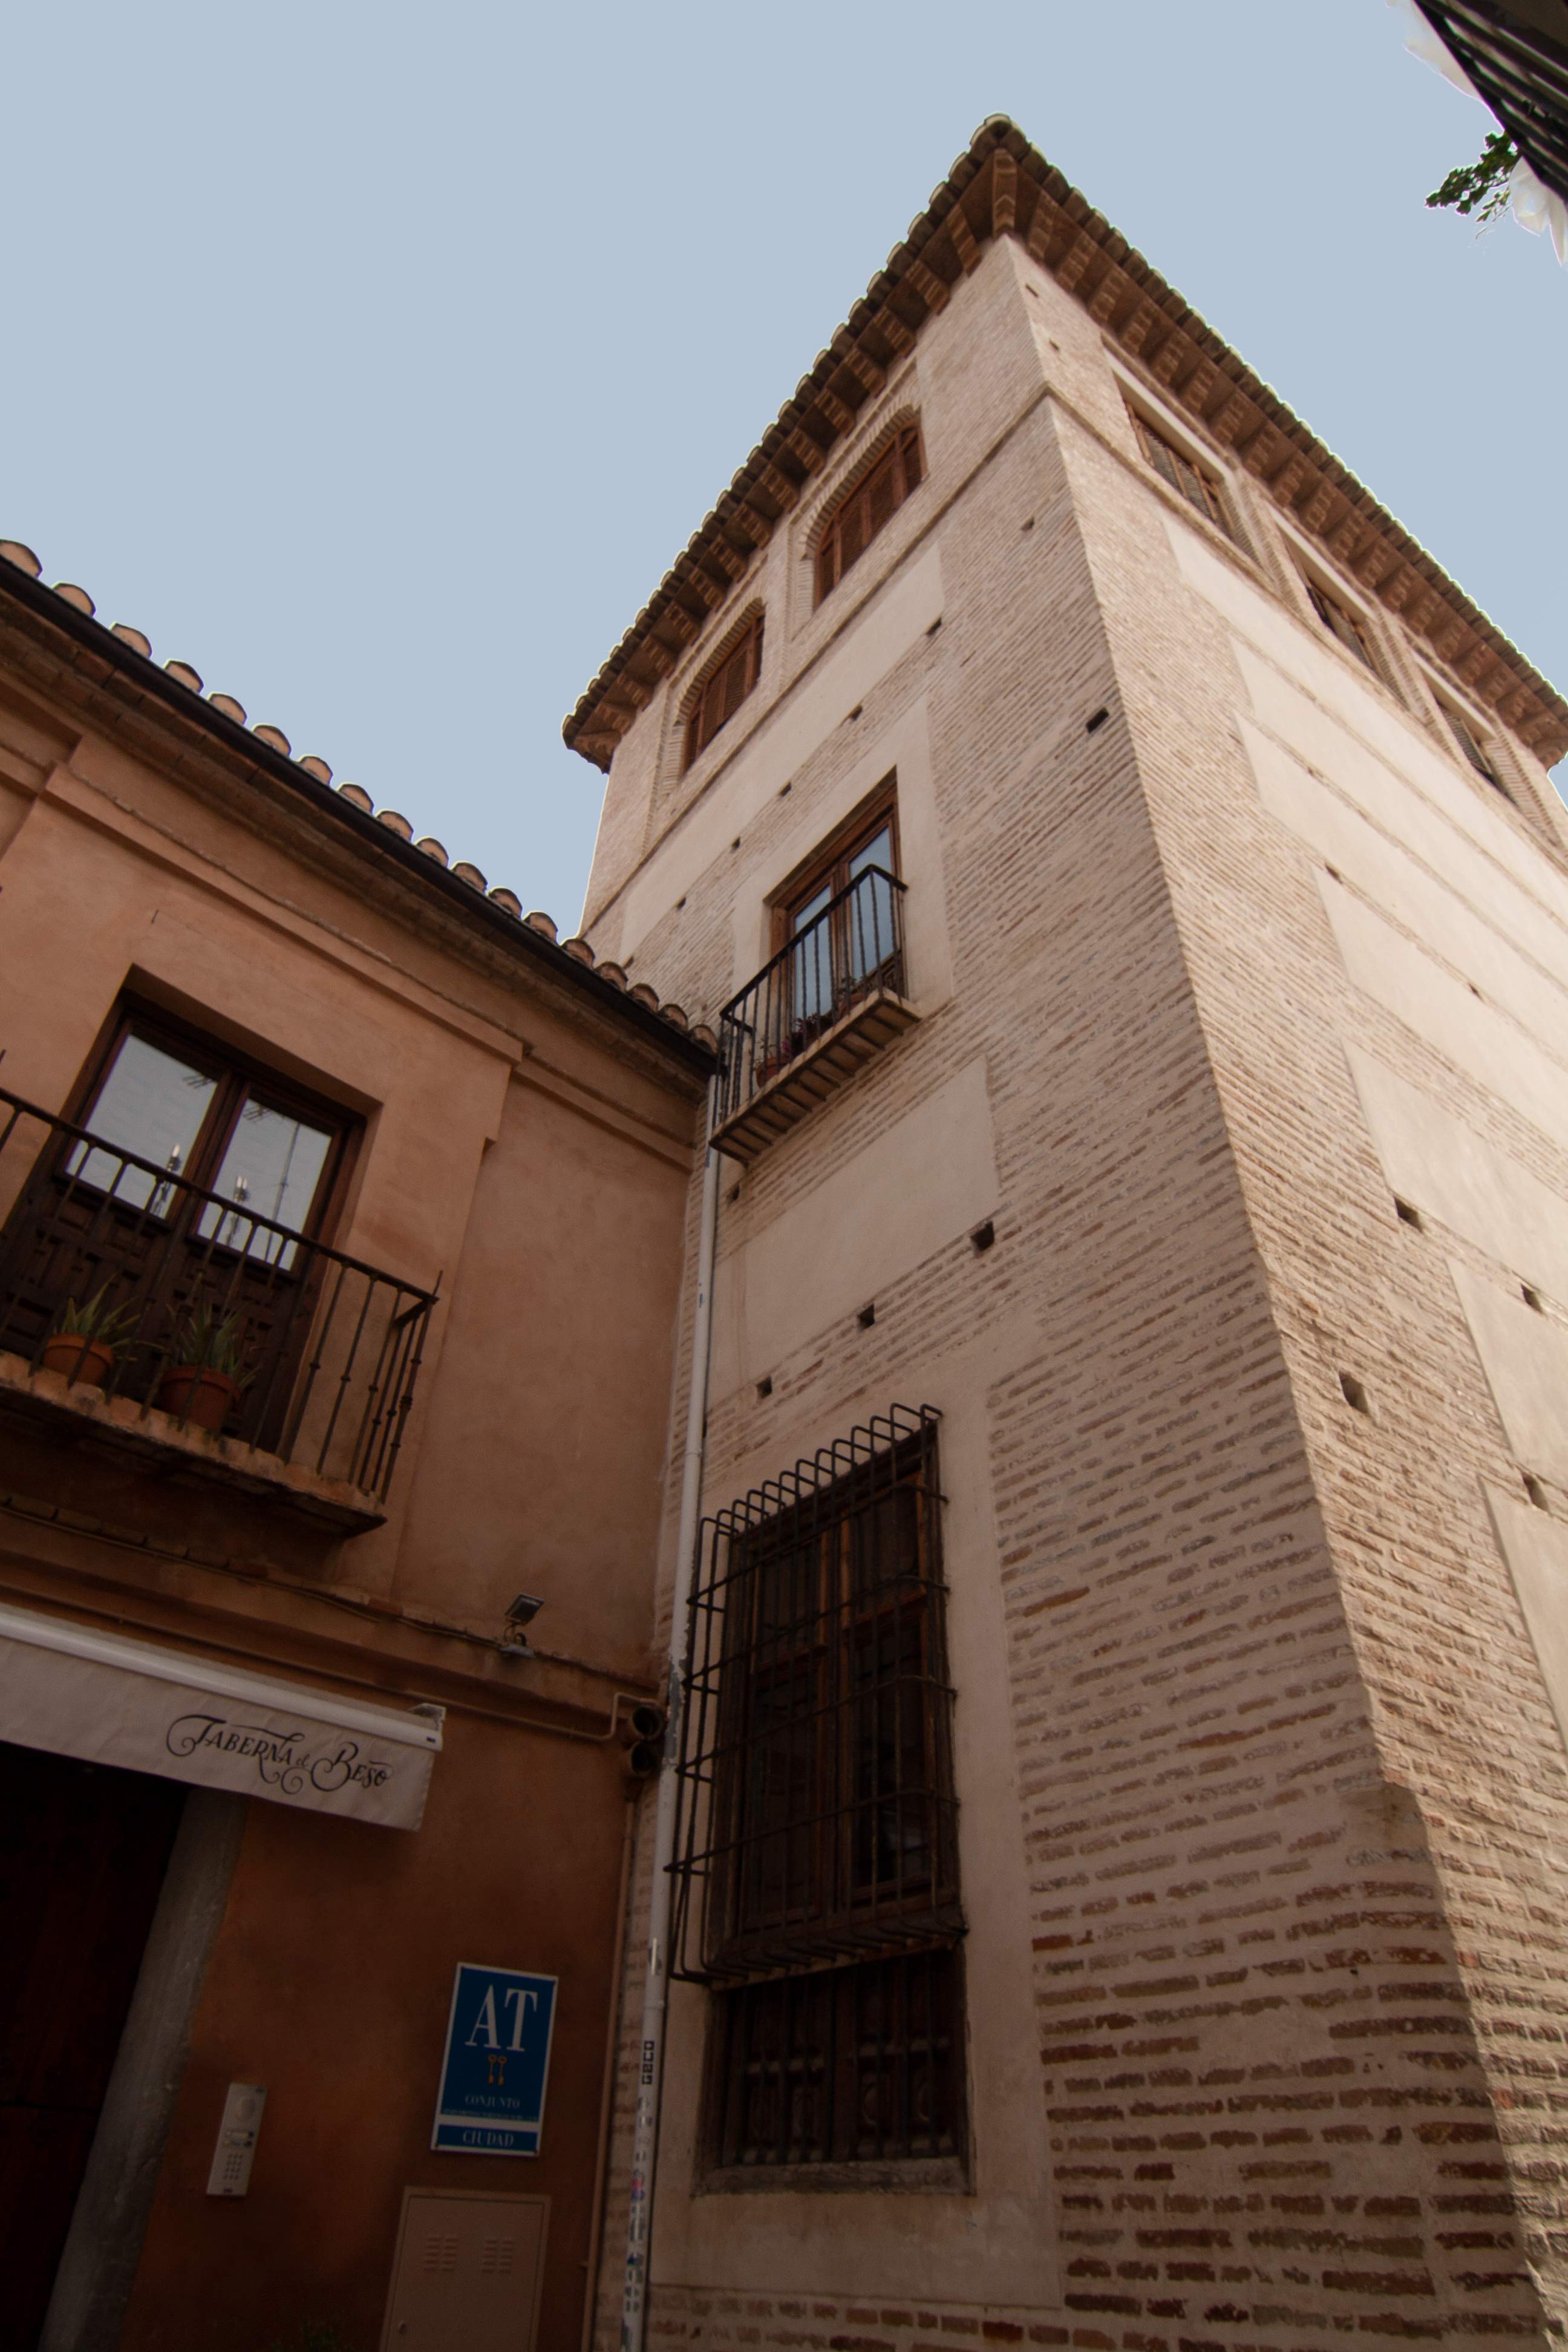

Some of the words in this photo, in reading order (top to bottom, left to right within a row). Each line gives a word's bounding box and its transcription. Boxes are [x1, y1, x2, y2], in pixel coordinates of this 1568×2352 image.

[464, 1984, 538, 2053] AT
[464, 2094, 521, 2110] CONJUNTO
[462, 2129, 515, 2148] CIUDAD
